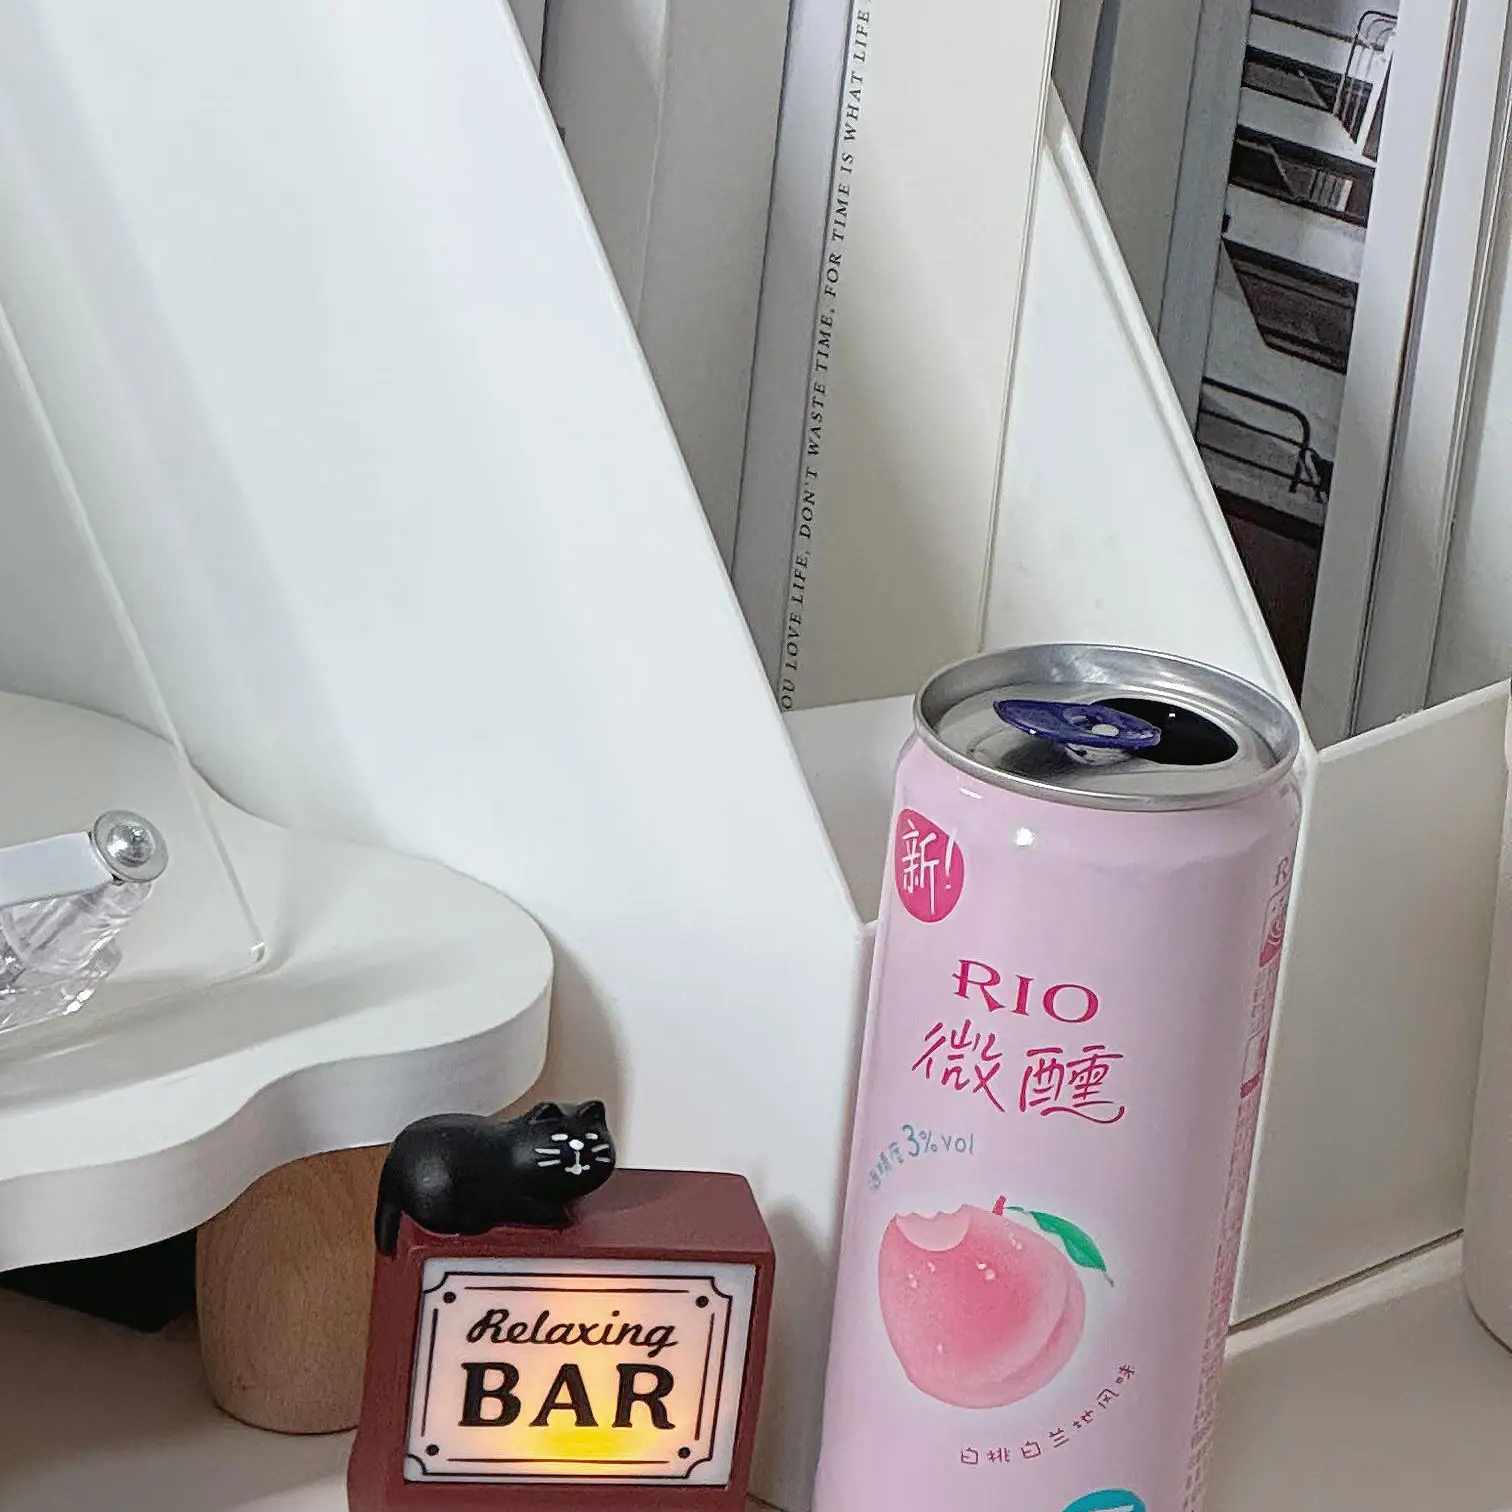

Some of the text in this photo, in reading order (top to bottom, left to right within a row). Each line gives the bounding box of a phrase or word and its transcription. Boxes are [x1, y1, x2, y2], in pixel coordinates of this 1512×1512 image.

[853, 9, 872, 64] LIFE
[844, 71, 865, 142] WHAT
[840, 152, 854, 175] IS
[832, 182, 852, 242] TIME
[824, 252, 843, 298] FOR
[808, 383, 827, 457] WASTE
[799, 466, 819, 539] DON'T
[791, 550, 811, 605] LIFE,
[786, 612, 805, 670] LOVE
[781, 679, 795, 709] OU
[951, 958, 1100, 1024] RIO
[466, 1309, 678, 1358] Relaxing
[458, 1361, 676, 1431] BAR
[959, 1362, 1136, 1466] 白桃白兰地风味
